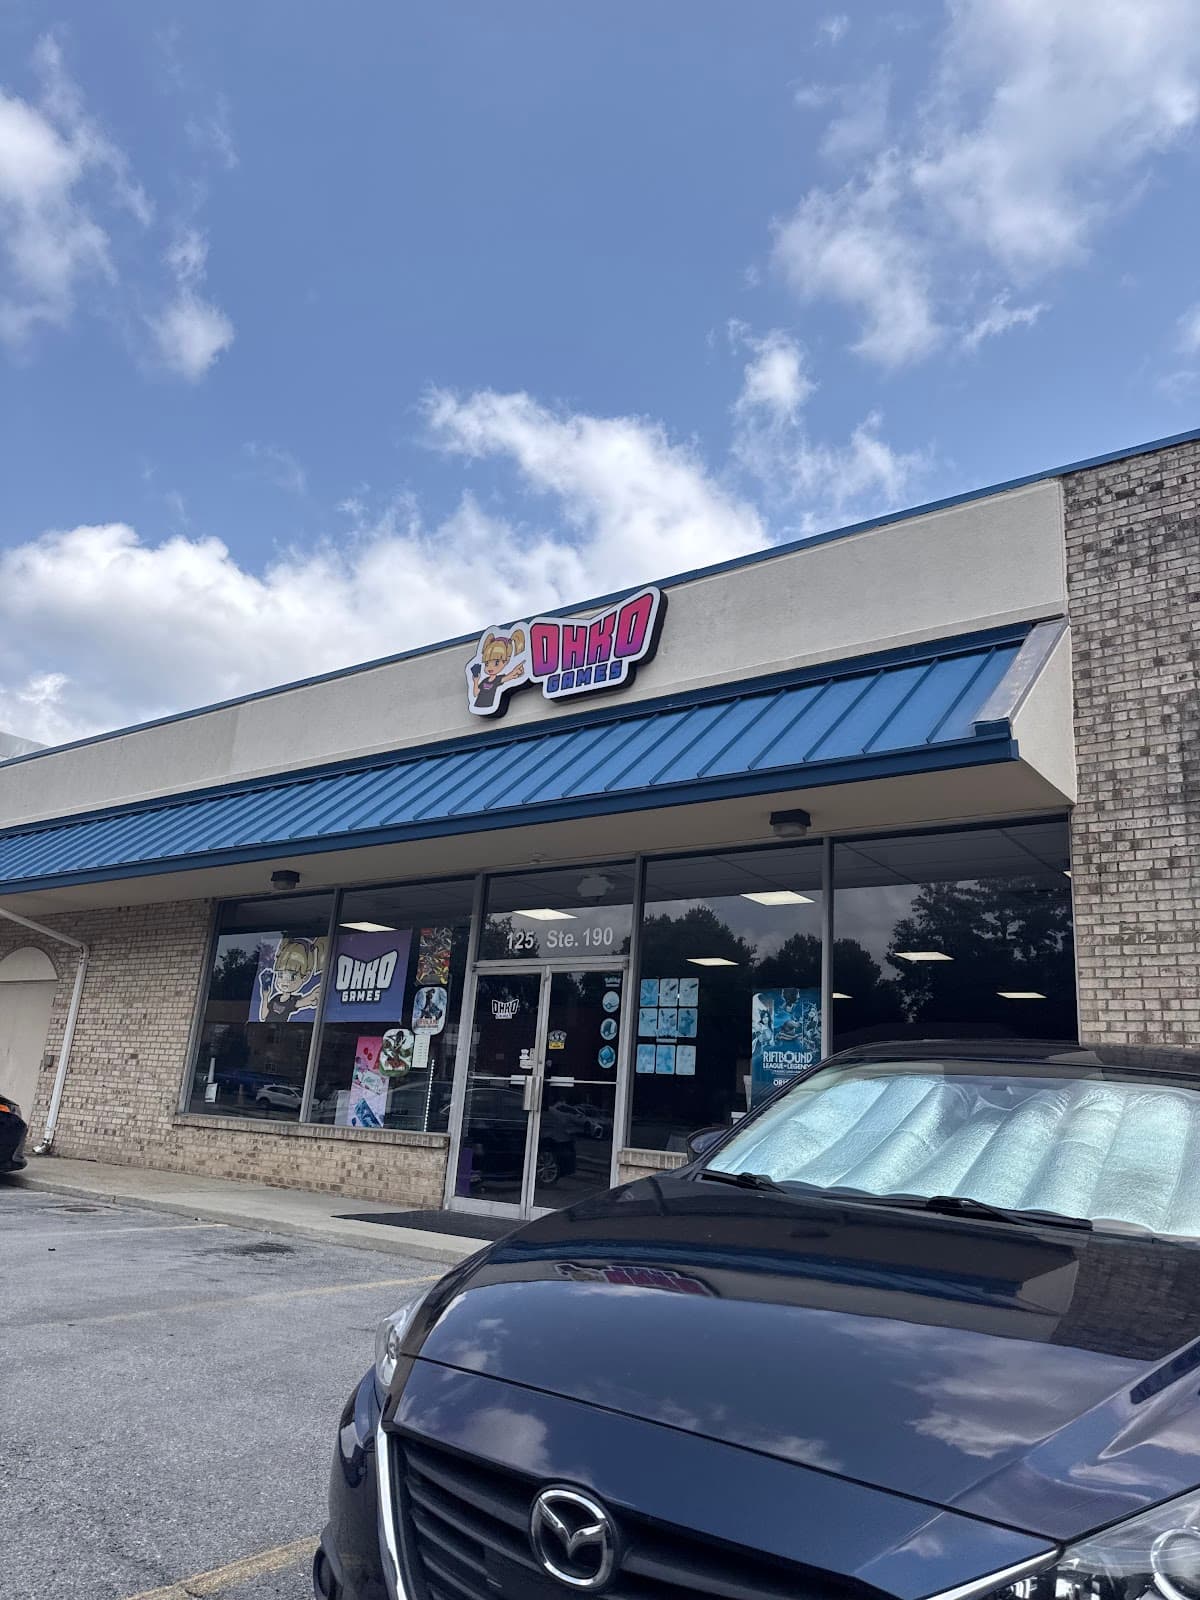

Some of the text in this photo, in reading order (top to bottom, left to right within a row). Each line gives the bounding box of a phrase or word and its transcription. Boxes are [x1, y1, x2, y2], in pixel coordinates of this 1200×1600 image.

[530, 593, 653, 677] OHKO
[546, 660, 623, 693] GAMES
[507, 927, 613, 950] 125 Ste. 190
[336, 950, 398, 990] OHKO
[341, 989, 381, 1002] GAMES
[763, 1051, 813, 1064] RIFTBOUND
